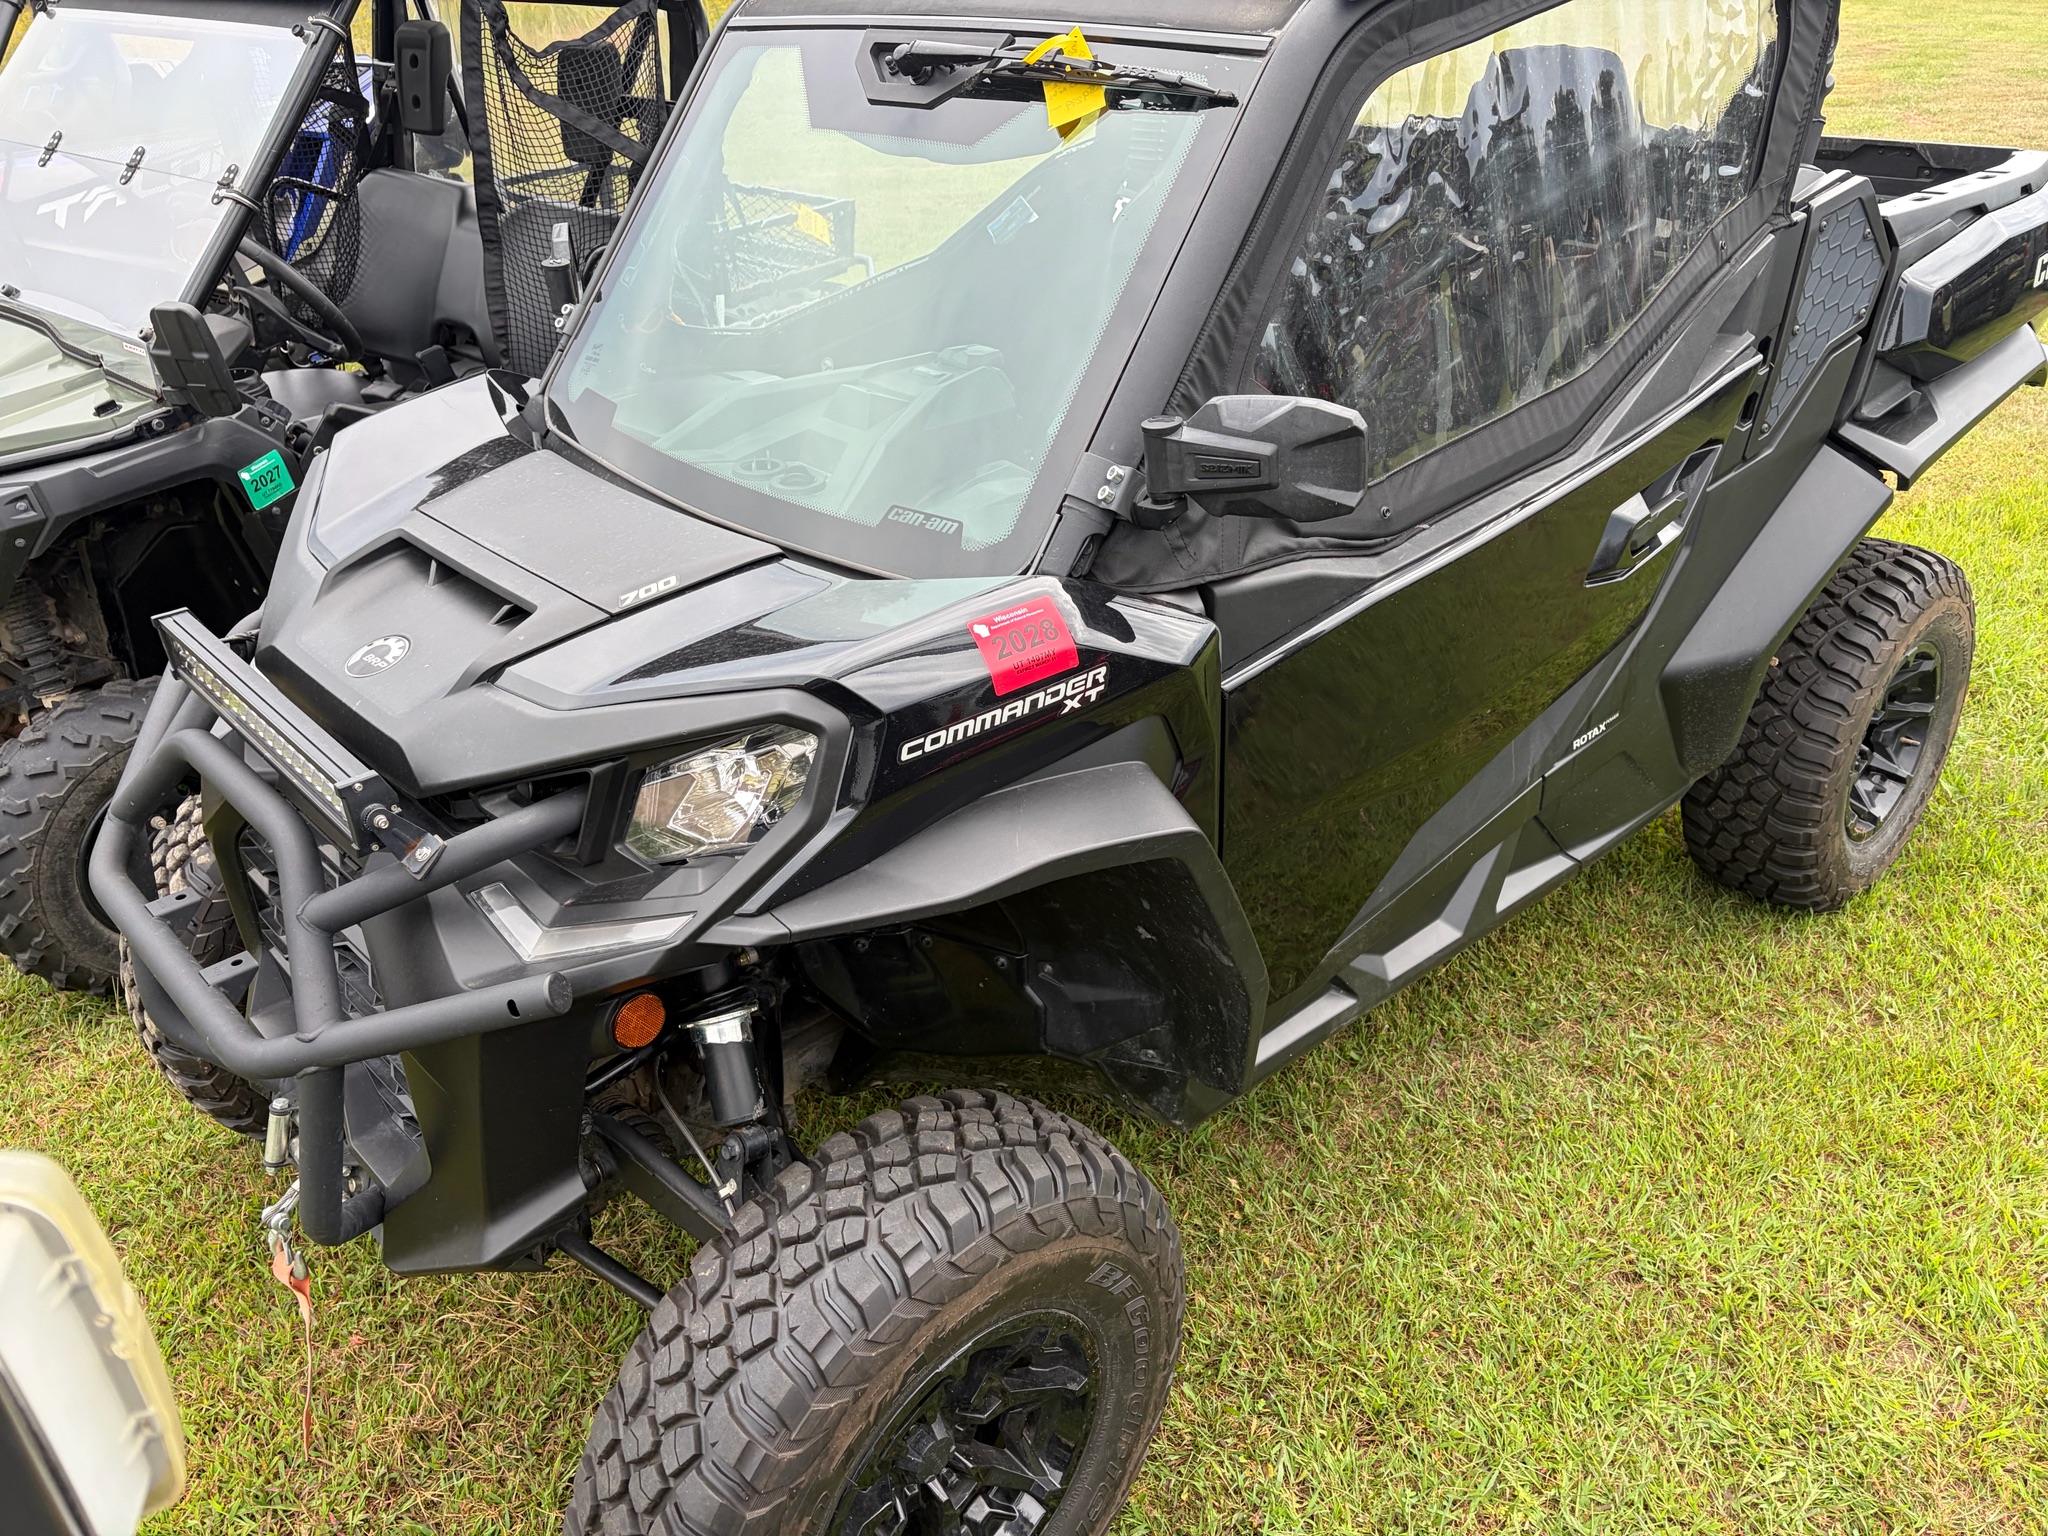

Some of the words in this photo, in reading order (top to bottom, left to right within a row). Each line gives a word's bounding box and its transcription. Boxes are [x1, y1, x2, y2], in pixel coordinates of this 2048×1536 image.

[251, 465, 281, 492] 2027
[1200, 463, 1253, 474] SEIZMIK
[887, 507, 959, 535] can-am
[620, 575, 677, 607] 700
[993, 606, 1029, 623] Wisconsin
[991, 618, 1060, 660] 2028
[362, 653, 388, 668] BRP
[1012, 659, 1024, 670] UT
[1026, 648, 1056, 665] 1407MY
[900, 665, 1108, 762] COMMANDER
[1060, 684, 1106, 715] XT
[1573, 721, 1607, 750] ROTAX
